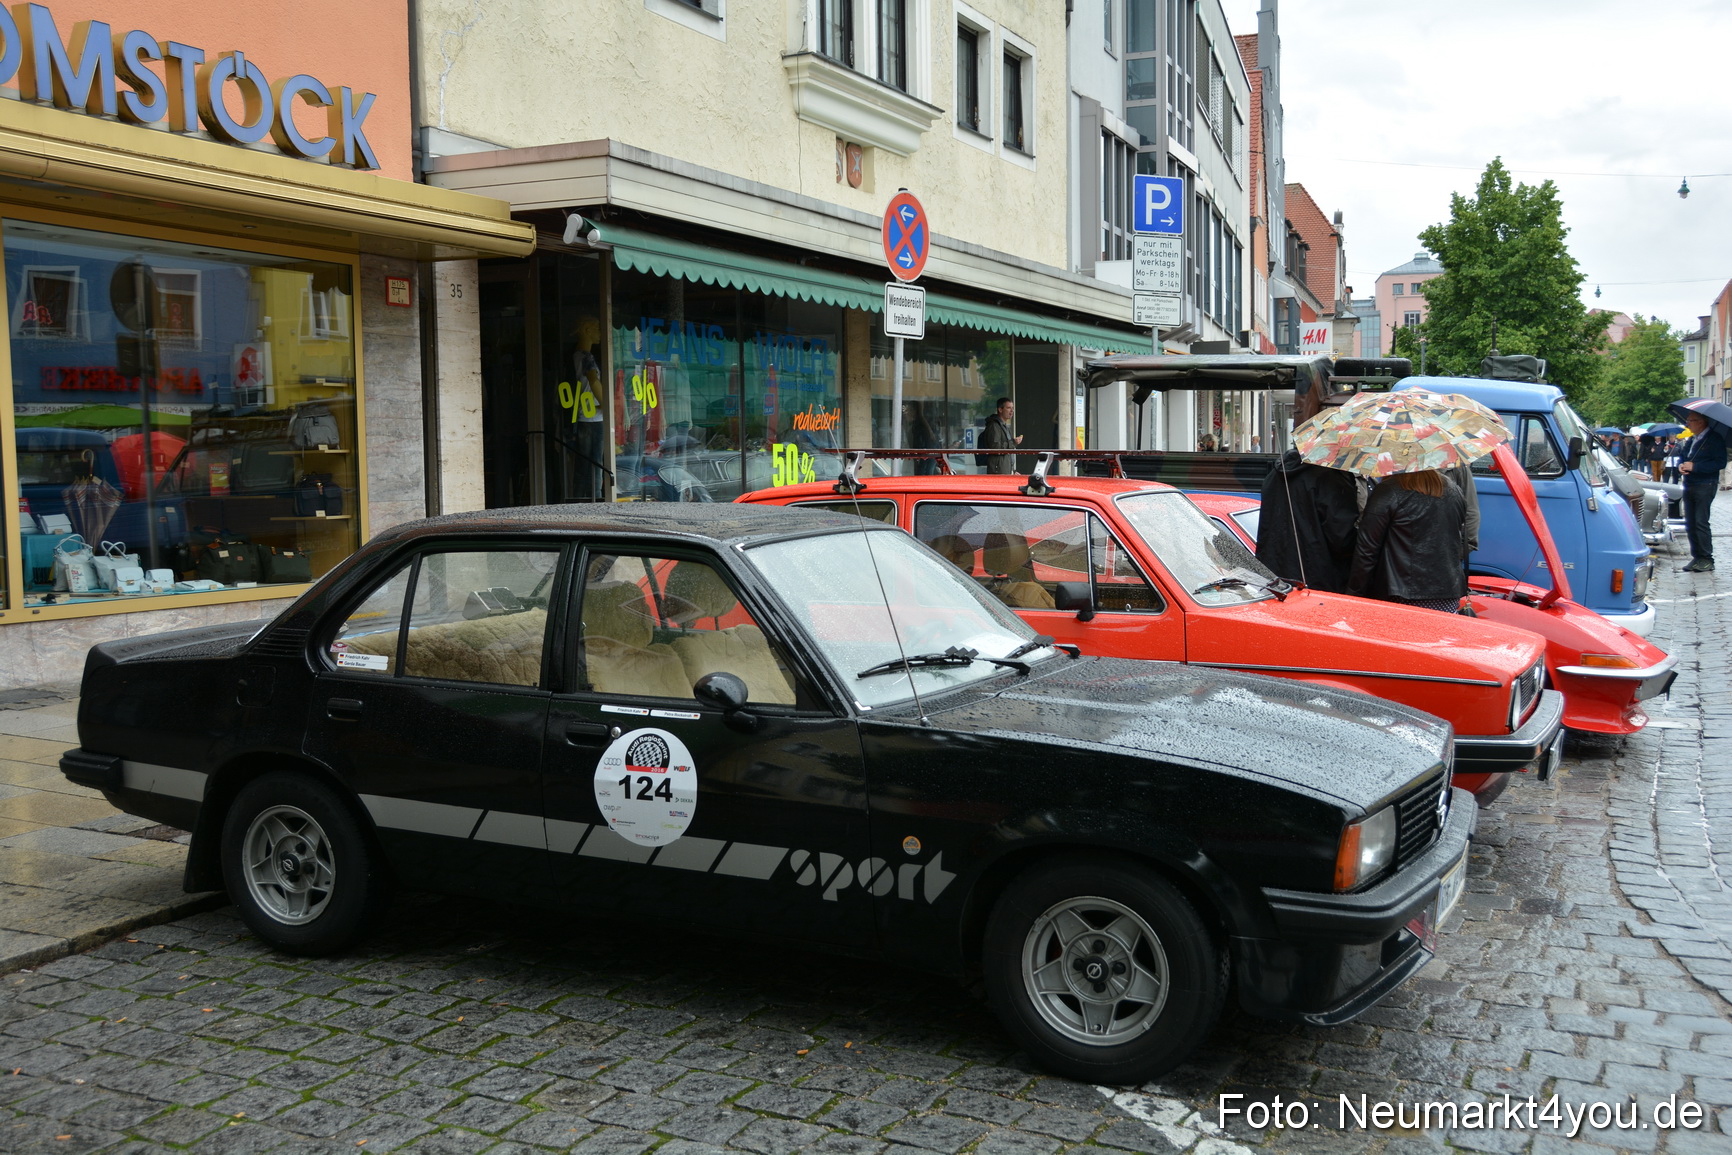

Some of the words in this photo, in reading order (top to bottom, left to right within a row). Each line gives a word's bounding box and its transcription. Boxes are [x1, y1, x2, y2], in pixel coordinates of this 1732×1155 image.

[1145, 183, 1172, 225] P
[1136, 248, 1179, 258] Parkschein
[1160, 241, 1172, 249] mit
[1140, 259, 1176, 269] werktags
[450, 283, 463, 298] 35
[1135, 278, 1145, 286] Sa
[888, 294, 922, 309] Wendebereich
[893, 313, 917, 327] freihalten
[631, 316, 724, 366] JEANS
[1302, 328, 1327, 345] H&M
[558, 381, 597, 423] %
[632, 369, 657, 415] %
[793, 404, 841, 433] reduziert!
[627, 738, 640, 757] Audi
[639, 735, 669, 760] RegioSprint
[618, 774, 674, 803] 124
[790, 849, 957, 905] sport
